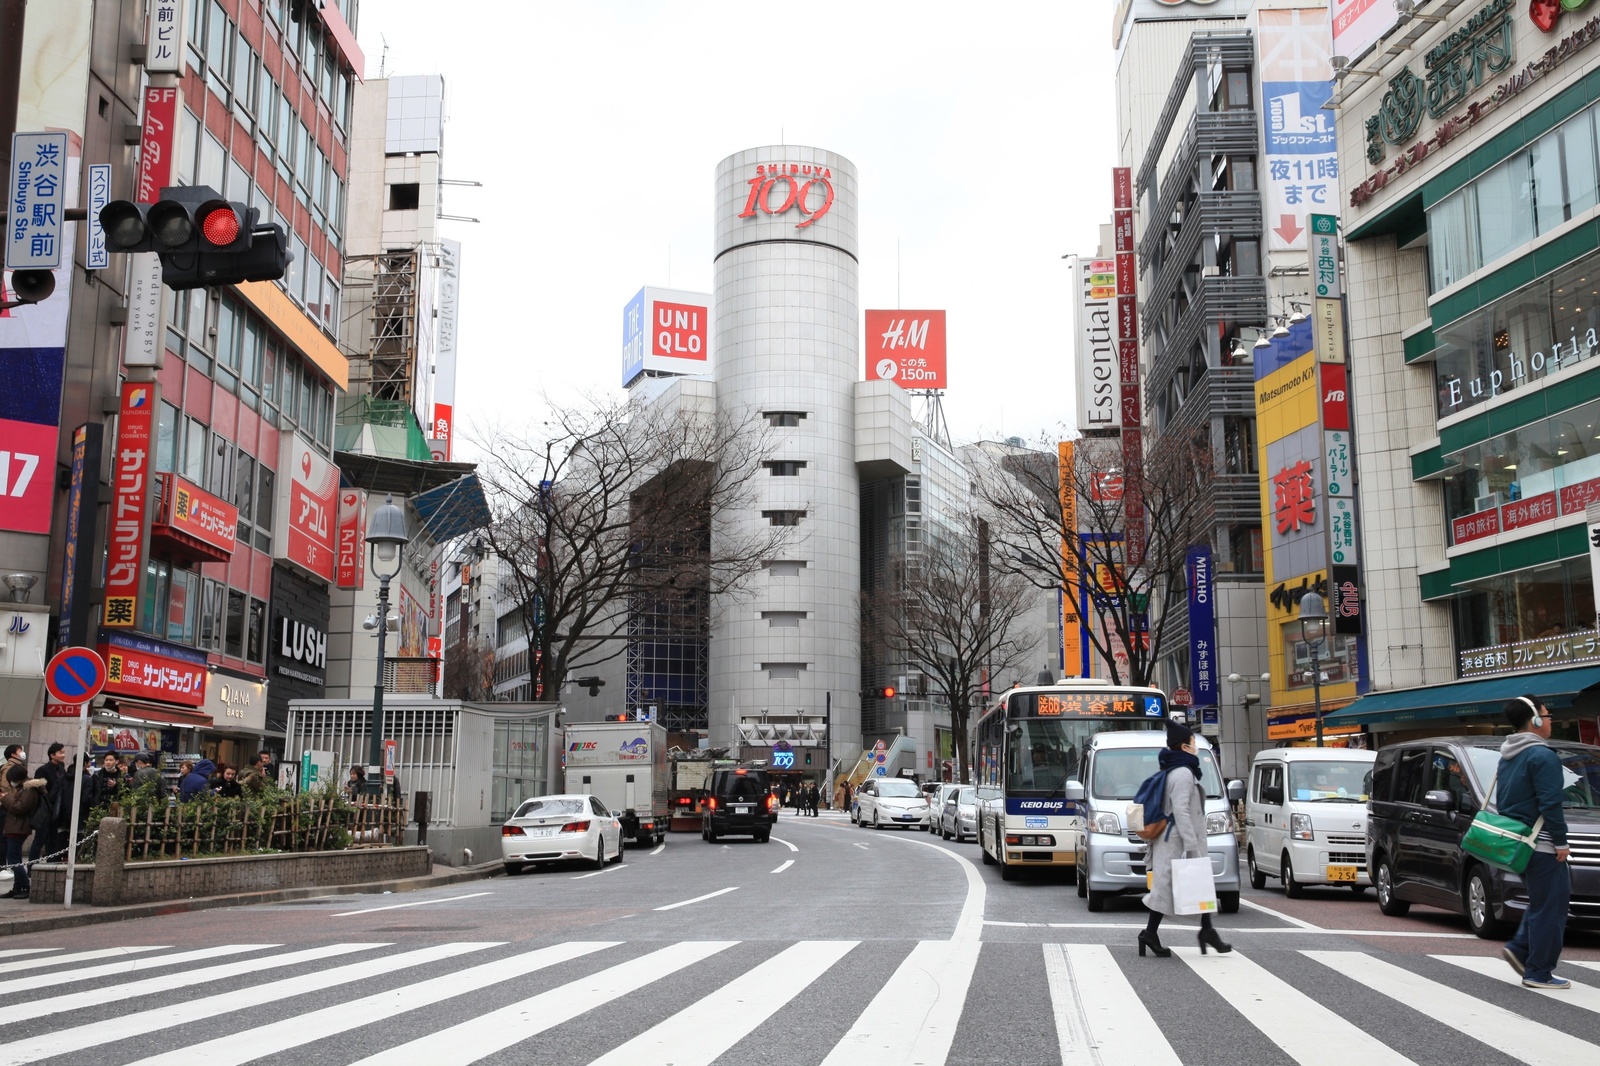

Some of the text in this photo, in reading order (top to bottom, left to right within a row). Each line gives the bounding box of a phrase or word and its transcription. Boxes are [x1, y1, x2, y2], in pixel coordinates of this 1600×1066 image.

[155, 0, 175, 59] 前ビル
[148, 89, 175, 103] 5F
[1271, 99, 1281, 131] BOOK
[1271, 135, 1335, 145] ブックファースト
[756, 163, 832, 179] SHIBUYA
[1269, 157, 1339, 181] 夜11時
[14, 160, 32, 244] Shibuya Sta.
[31, 143, 59, 258] 渋谷駅前
[737, 174, 835, 229] 109
[1284, 183, 1327, 205] まで
[1318, 237, 1335, 284] 渋谷西村
[149, 257, 159, 306] studio
[133, 307, 142, 332] york
[627, 303, 640, 339] THE
[659, 308, 698, 329] UNI
[1325, 303, 1335, 352] Euphoria
[658, 331, 701, 354] QLO
[882, 319, 930, 351] H&M
[623, 330, 643, 374] PRIME
[901, 358, 926, 368] この先
[1085, 301, 1114, 425] Essential
[1447, 326, 1600, 407] Euphoria
[900, 367, 937, 380] 150m
[1259, 374, 1302, 405] Matsumoto
[1324, 389, 1345, 403] JTB
[1329, 448, 1338, 481] パーラー
[1338, 443, 1348, 477] フルーツ
[177, 491, 188, 519] 薬
[1273, 460, 1317, 536] 薬
[1507, 498, 1553, 525] 海外旅行
[110, 448, 145, 586] サンドラッグ
[200, 510, 235, 541] サンドラッグ
[299, 491, 328, 538] アコム
[1342, 511, 1353, 547] 渋谷西村
[1456, 514, 1497, 539] 国内旅行
[1063, 510, 1075, 573] Matsoto
[1333, 515, 1342, 549] フルーツ
[307, 544, 318, 565] 3F
[341, 529, 353, 566] アコム
[1196, 556, 1207, 604] MIZUHO
[107, 598, 132, 624] 薬
[1339, 581, 1359, 617] HUB
[9, 616, 30, 634] ル
[1065, 612, 1077, 624] 薬
[282, 617, 327, 669] LUSH
[1465, 638, 1600, 670] 渋谷西村 フルーツパーラ
[110, 656, 121, 680] 薬
[128, 660, 140, 668] DRUG
[143, 663, 193, 693] サンドラッグ
[1197, 640, 1210, 691] みずほ銀行
[122, 675, 142, 685] COSMETIC
[57, 704, 74, 713] 入口
[220, 684, 250, 707] DIANA
[1038, 696, 1060, 715] 渋66
[1061, 700, 1135, 712] 渋谷駅
[226, 708, 244, 719] BAGS
[581, 742, 597, 750] JRC
[773, 757, 794, 769] 109
[1020, 801, 1064, 809] KEIO BUS
